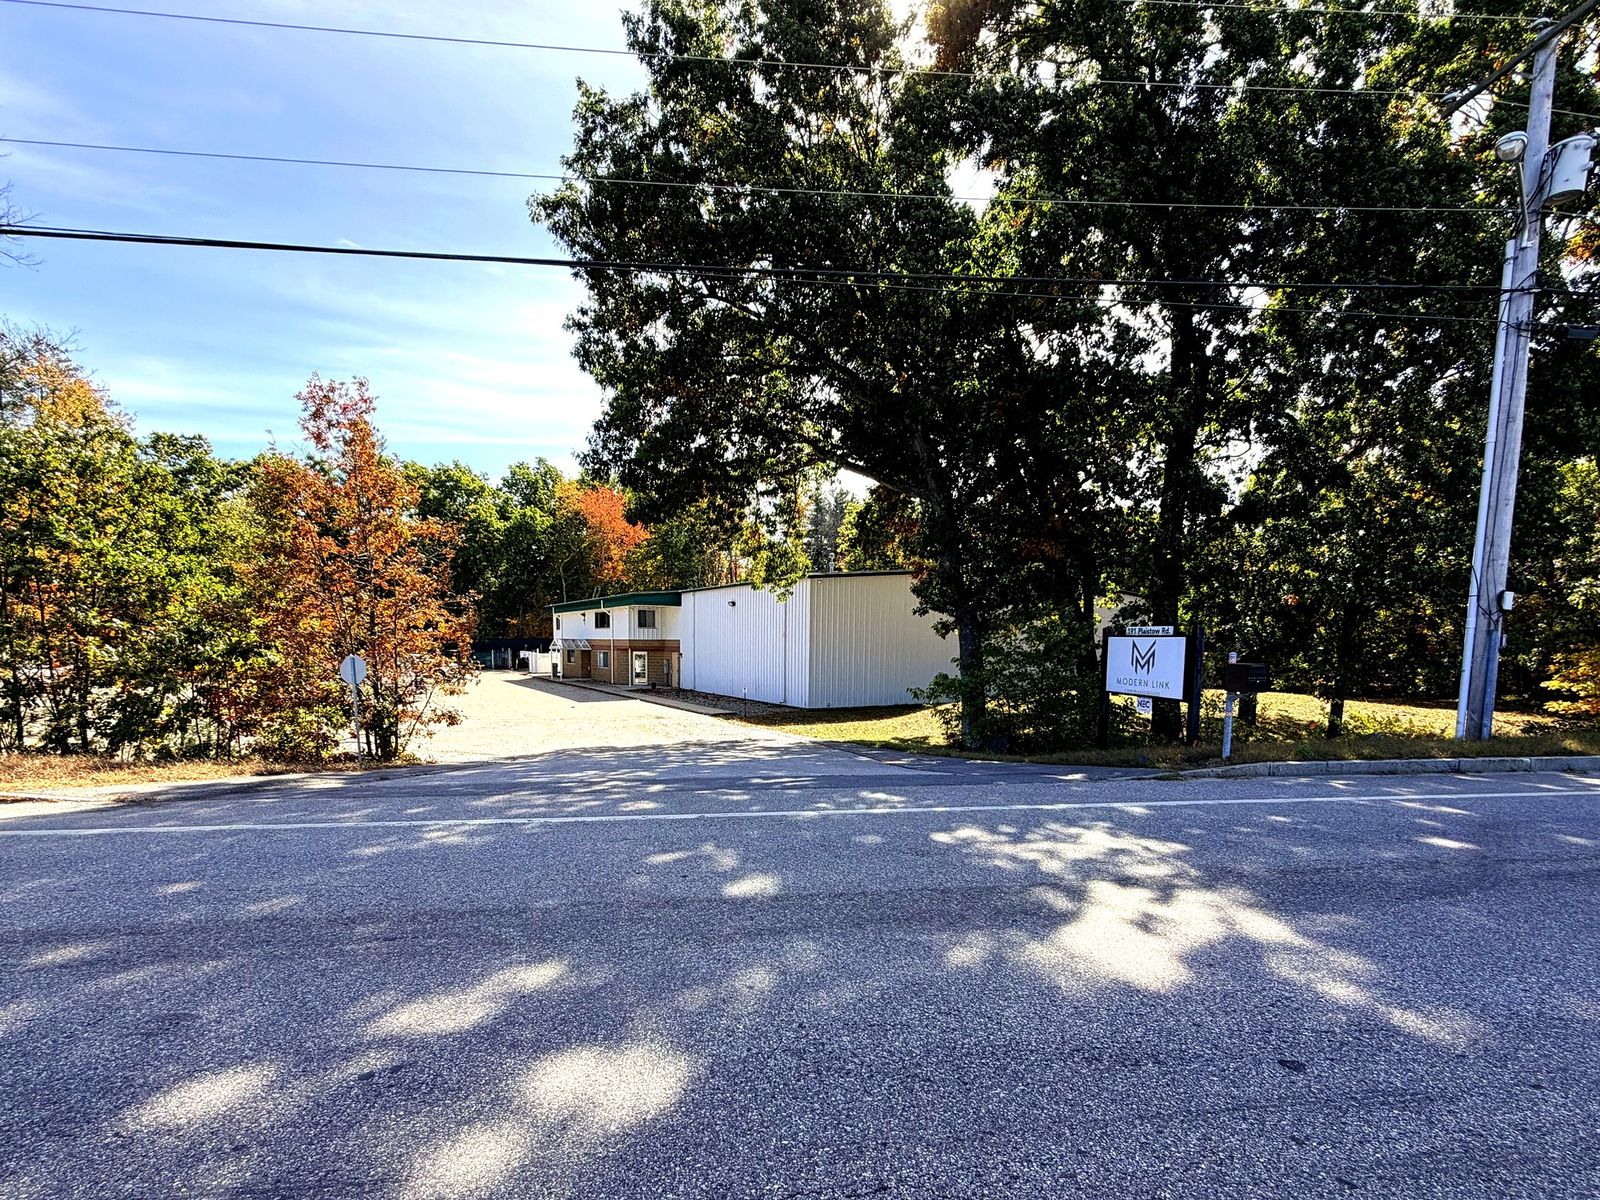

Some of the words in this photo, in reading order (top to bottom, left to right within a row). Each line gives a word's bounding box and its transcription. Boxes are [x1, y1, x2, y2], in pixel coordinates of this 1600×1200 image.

[1127, 627, 1137, 635] 191
[1138, 627, 1160, 635] Plaistow
[1161, 627, 1171, 635] Rd.
[1116, 677, 1149, 687] MODERN
[1151, 680, 1170, 690] LINK
